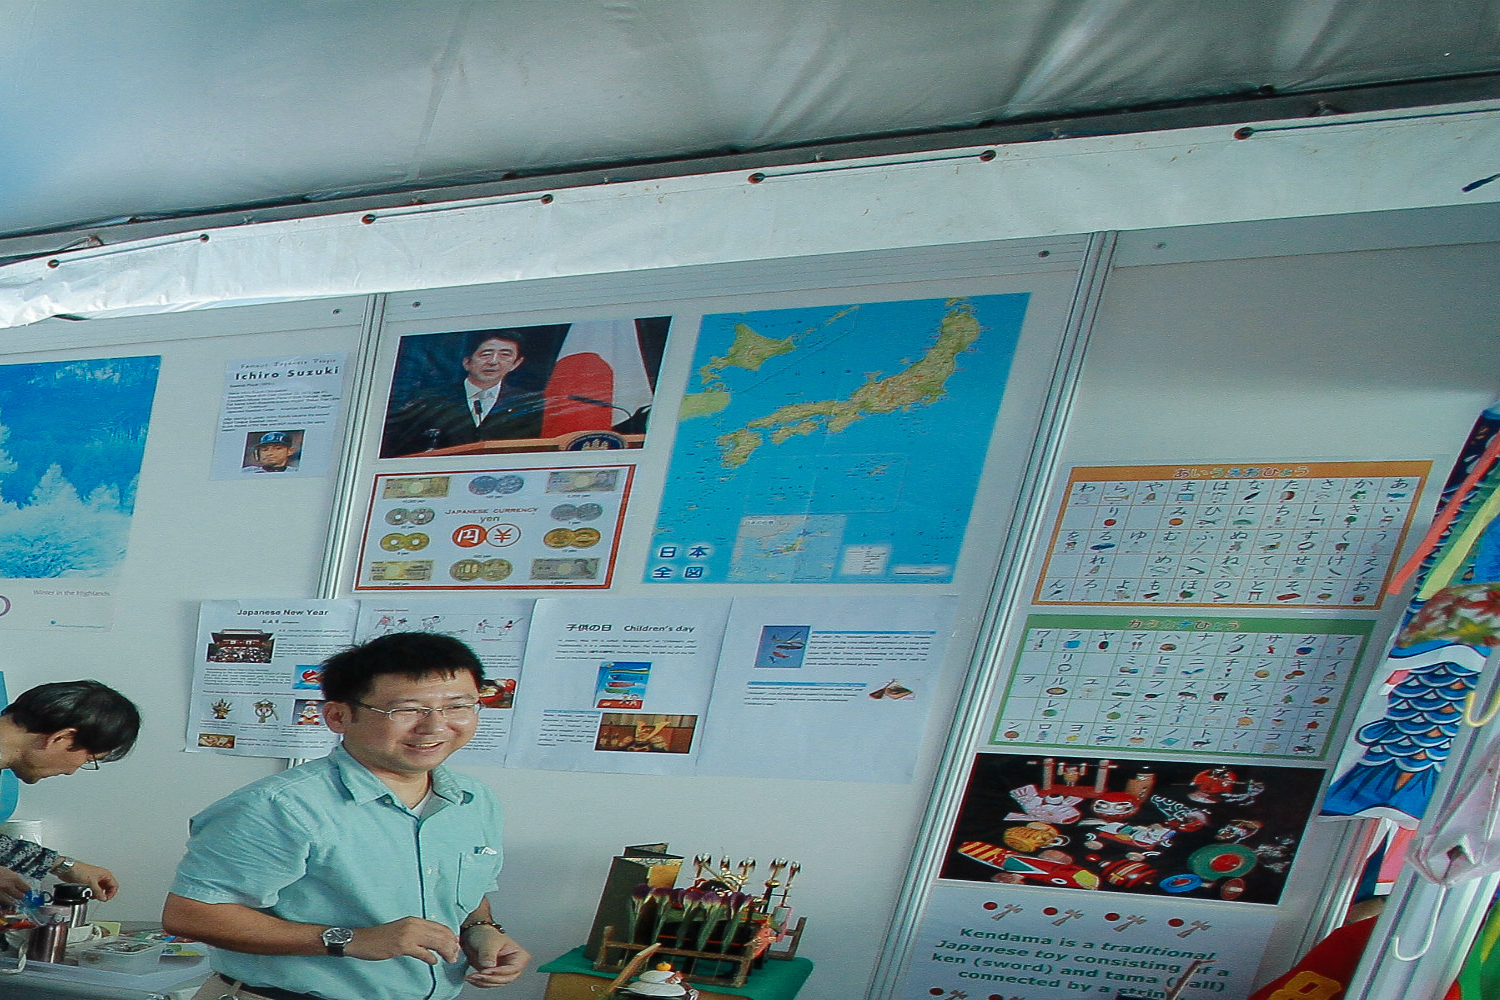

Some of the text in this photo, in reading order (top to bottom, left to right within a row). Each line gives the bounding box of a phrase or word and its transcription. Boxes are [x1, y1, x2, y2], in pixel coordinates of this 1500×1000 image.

[236, 367, 338, 380] Ichiro Suzuki
[1079, 479, 1408, 492] わ ら や ま は な た か あ
[1171, 507, 1188, 515] み
[1205, 507, 1220, 515] ひ
[1238, 507, 1254, 515] に
[1277, 506, 1289, 515] ち
[1313, 505, 1322, 515] し
[457, 529, 479, 544] 円
[1100, 532, 1112, 540] る
[1131, 532, 1147, 540] ゆ
[1164, 532, 1181, 540] む
[1301, 531, 1318, 540] す
[1342, 531, 1350, 541] く
[1377, 531, 1387, 541] う
[660, 546, 708, 558] 日本
[1222, 556, 1239, 564] ね
[1259, 556, 1274, 565] て
[1293, 556, 1310, 565] せ
[1328, 556, 1346, 565] け
[653, 566, 703, 578] 全図
[1050, 580, 1065, 588] ん
[1084, 580, 1097, 588] ろ
[1117, 580, 1130, 589] よ
[1150, 580, 1162, 589] も
[1214, 581, 1231, 589] の
[1252, 581, 1265, 590] と
[1321, 582, 1333, 590] こ
[1037, 630, 1051, 638] ワ
[1198, 633, 1213, 641] ナ
[1233, 634, 1247, 642] タ
[1265, 635, 1282, 643] サ
[1302, 635, 1317, 644] カ
[1292, 660, 1307, 669] キ
[1330, 661, 1346, 669] イ
[1250, 684, 1262, 692] ス
[1285, 685, 1299, 693] ク
[1319, 686, 1334, 694] ウ
[1109, 702, 1122, 710] メ
[1207, 706, 1222, 714] テ
[1240, 707, 1257, 715] セ
[1132, 727, 1148, 735] ホ
[1202, 729, 1211, 738] ト
[1300, 734, 1316, 743] オ
[960, 928, 1052, 944] Kendama
[1060, 938, 1076, 947] is
[1101, 942, 1217, 960] traditional
[935, 940, 1028, 956] Japanese
[1035, 950, 1068, 961] toy
[1074, 955, 1181, 974] consisting
[932, 953, 1225, 992] ken (sword) and tama (all)
[958, 971, 1060, 988] connected
[1067, 980, 1091, 992] by
[1118, 988, 1185, 1000] strin.
